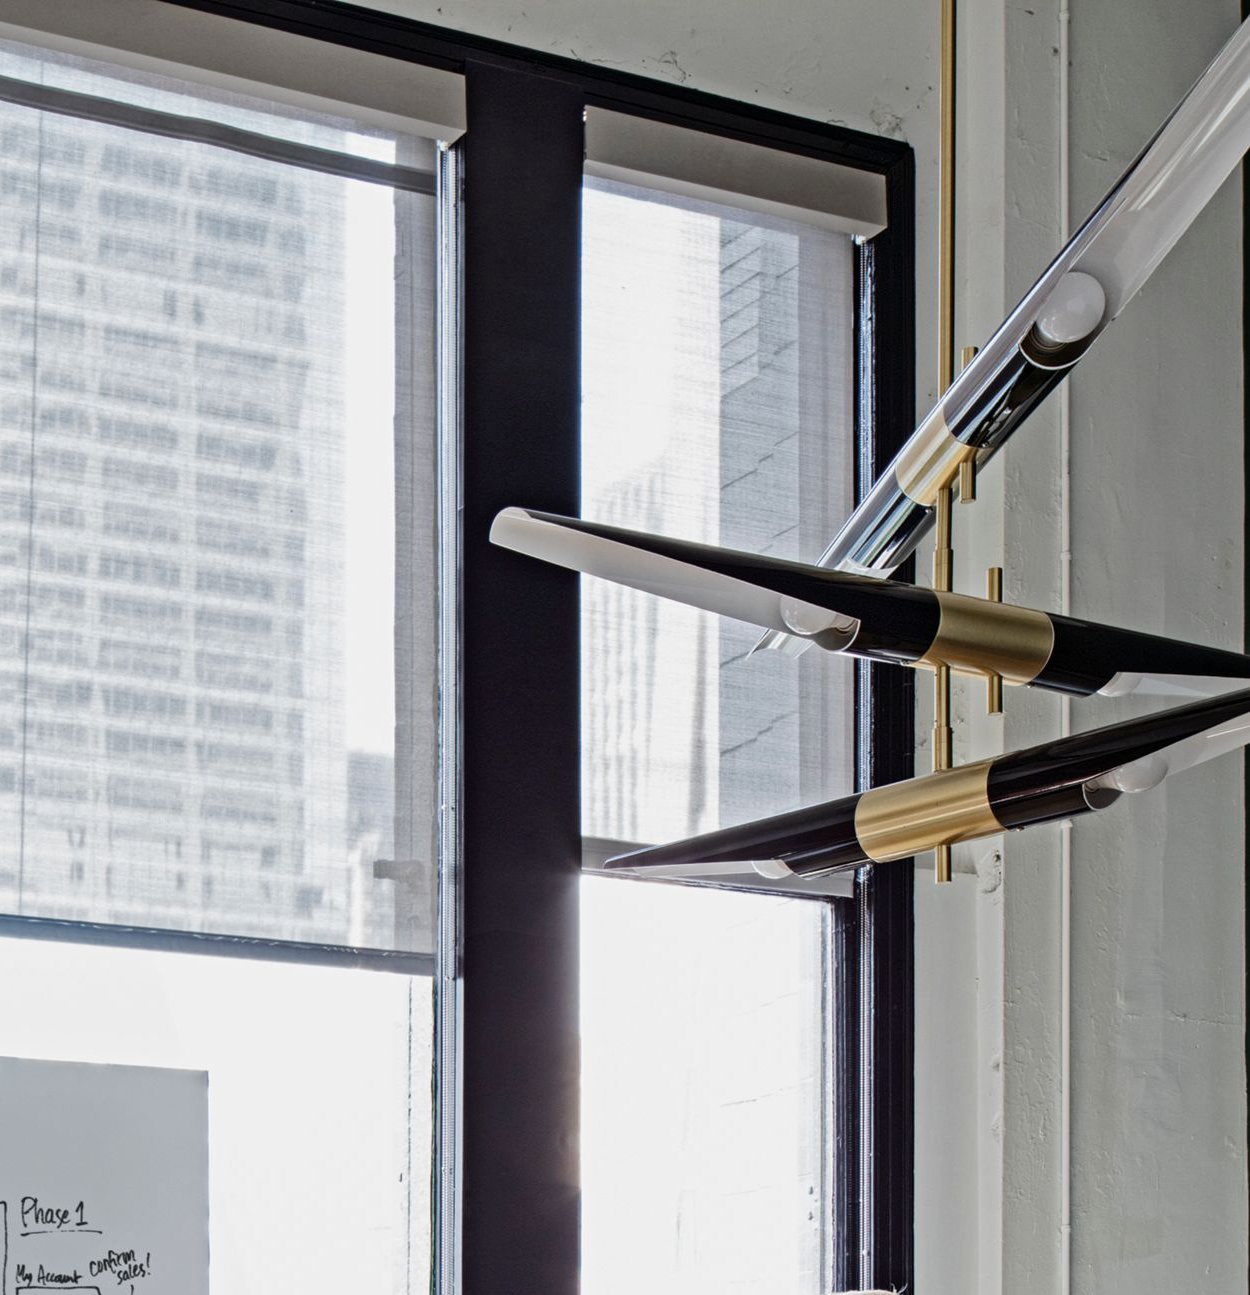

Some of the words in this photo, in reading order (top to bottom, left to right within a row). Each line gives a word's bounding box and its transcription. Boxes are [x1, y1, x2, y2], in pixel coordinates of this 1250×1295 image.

[21, 1196, 71, 1229] Phase
[75, 1200, 89, 1227] 1
[15, 1264, 33, 1288] My
[37, 1264, 83, 1286] Account
